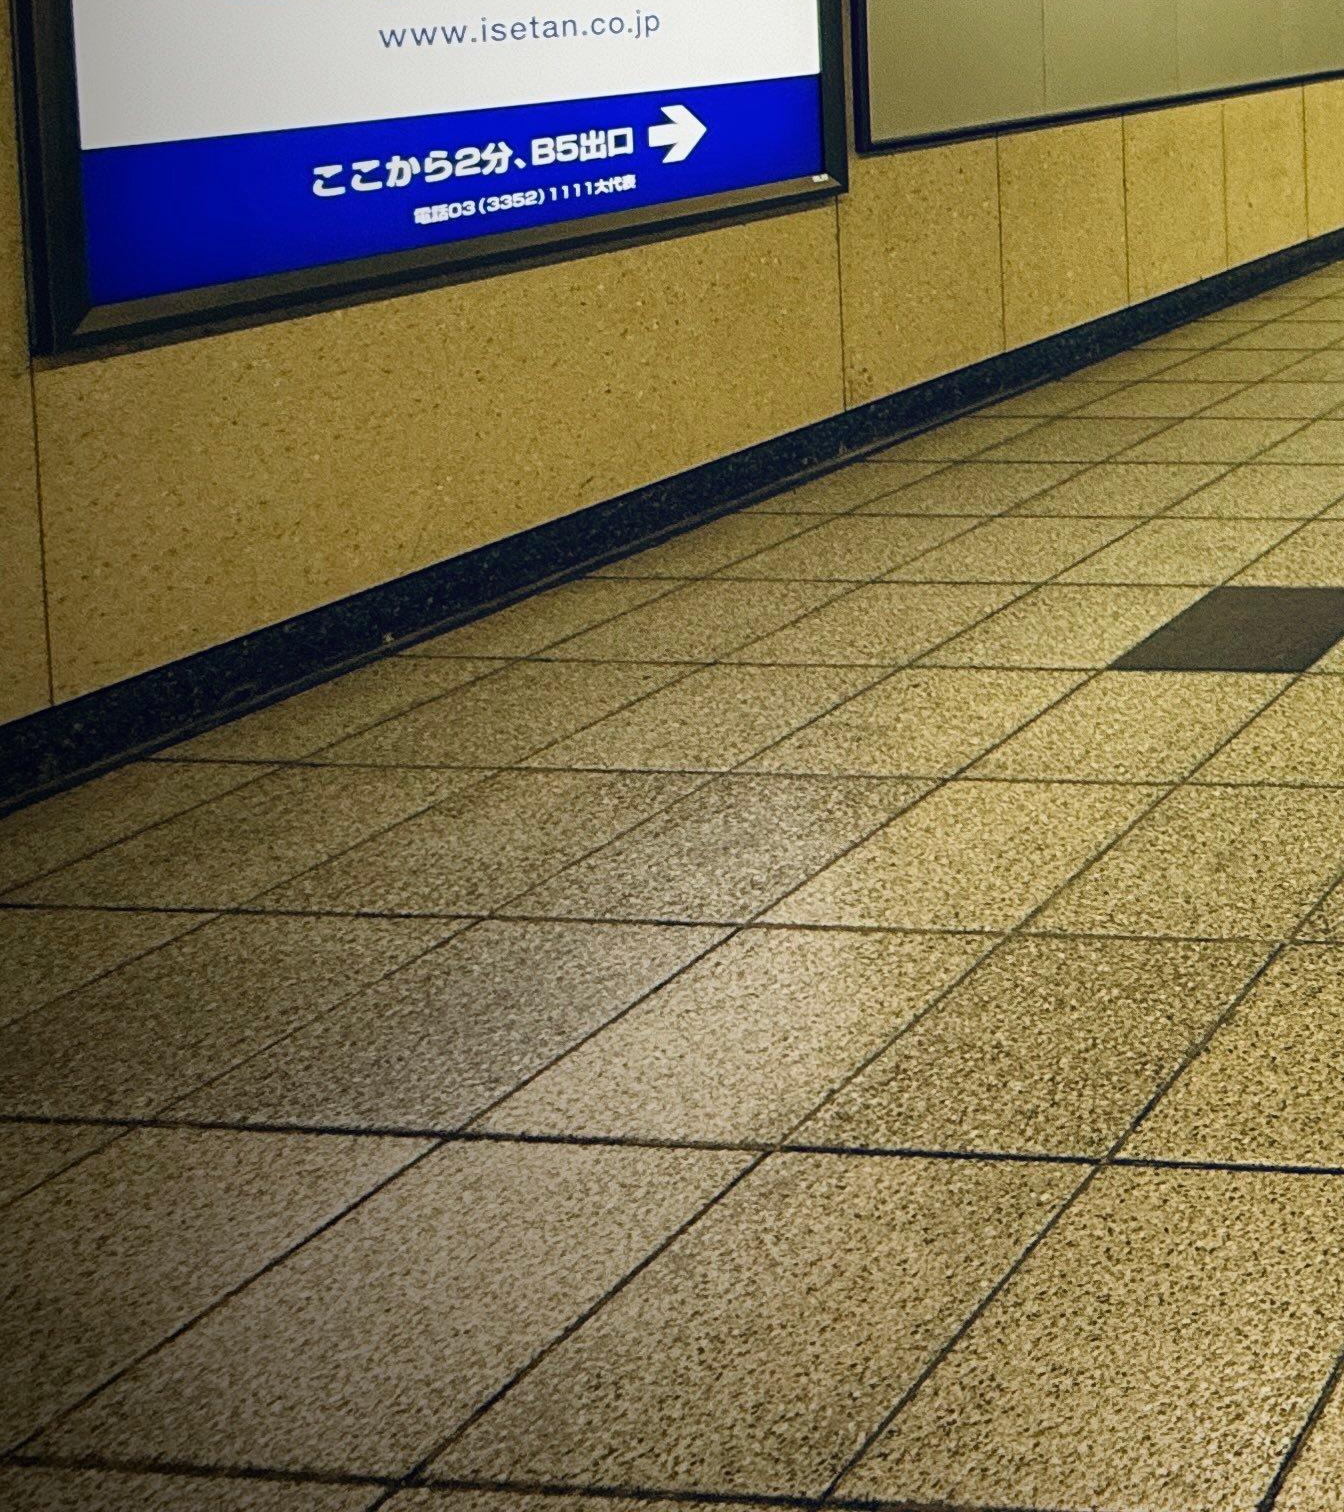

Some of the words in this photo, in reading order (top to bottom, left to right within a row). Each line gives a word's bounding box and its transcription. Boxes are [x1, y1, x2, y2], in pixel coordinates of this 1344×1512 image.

[377, 8, 661, 49] www.isetan.co.jp
[311, 126, 635, 198] ここから2分、B5出口
